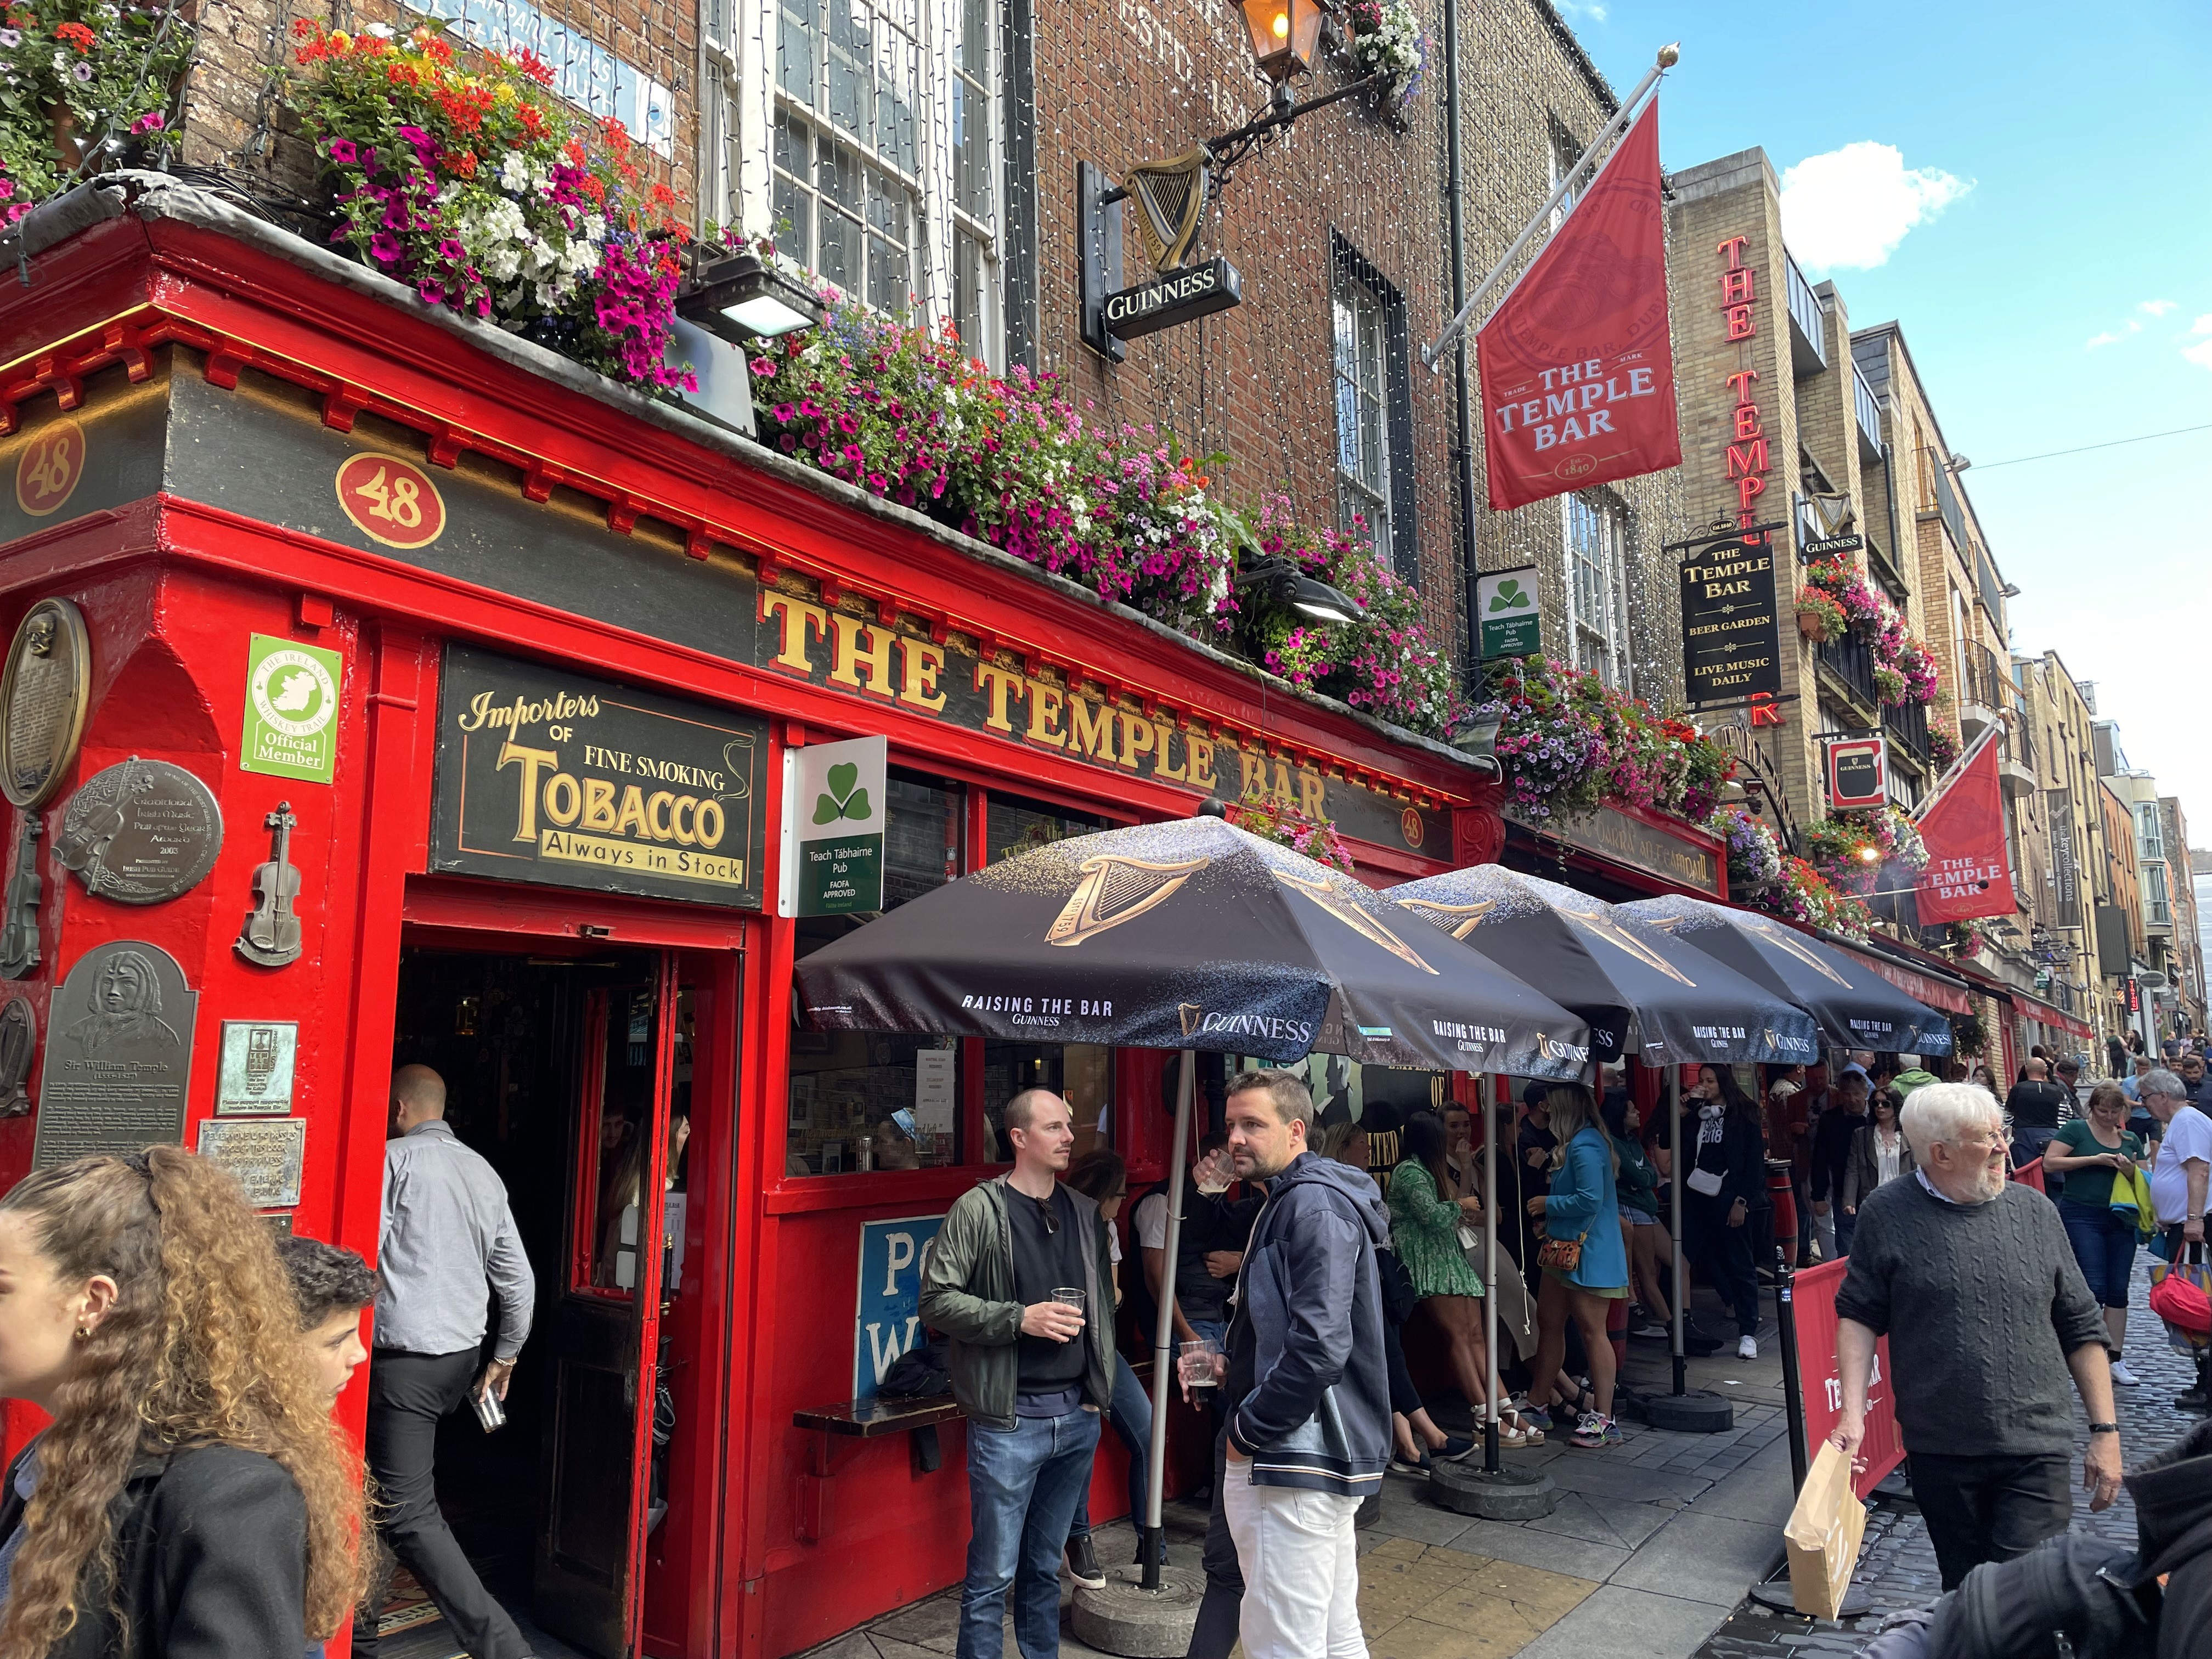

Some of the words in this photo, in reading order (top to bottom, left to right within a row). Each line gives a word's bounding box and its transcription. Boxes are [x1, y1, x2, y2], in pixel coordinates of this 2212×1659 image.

[1147, 229, 1161, 252] 1759
[1107, 268, 1215, 320] GUINNESS
[1717, 235, 1758, 343] THE
[1515, 319, 1567, 359] TEMPLE
[1503, 386, 1526, 397] TRADE
[1538, 358, 1604, 391] THE
[1620, 352, 1643, 363] MARK
[1496, 367, 1657, 434] TEMPLE
[1533, 409, 1617, 452] BAR
[1724, 369, 1773, 544] TEMPL
[25, 437, 70, 498] 48
[1564, 463, 1589, 476] 1840
[355, 466, 422, 528] 48
[1712, 548, 1741, 561] THE
[1805, 537, 1859, 554] GUINNESS
[1684, 557, 1771, 584] TEMPLE
[1705, 579, 1752, 599] BAR
[1488, 623, 1504, 631] Teach
[1689, 623, 1719, 637] BEER
[1721, 615, 1771, 631] GARDEN
[261, 654, 283, 674] THE
[285, 653, 329, 685] IRELAND
[1694, 663, 1724, 676] LIVE
[1726, 657, 1770, 672] MUSIC
[1712, 673, 1752, 687] DAILY
[259, 700, 297, 733] WHISKEY
[301, 715, 326, 733] TRAIL
[459, 691, 600, 742] Importers
[760, 589, 947, 714] THE
[974, 661, 1218, 791] TEMPLE
[1238, 750, 1327, 823] BAR
[265, 732, 317, 753] Official
[549, 724, 573, 743] OF
[258, 746, 321, 767] Member
[1839, 763, 1871, 771] GUINNESS
[583, 745, 631, 774] FINE
[636, 756, 725, 792] SMOKING
[496, 741, 726, 849] TOBACCO
[1045, 823, 1063, 840] The
[1404, 817, 1419, 839] 48
[160, 847, 179, 855] 2003
[545, 832, 634, 865] Always
[648, 848, 667, 870] in
[678, 851, 739, 881] Stock
[809, 851, 832, 862] Teach
[833, 847, 873, 859] Tábhairne
[833, 862, 848, 873] Pub
[1940, 857, 1974, 871] THE
[823, 889, 856, 899] APPROVED
[830, 880, 849, 889] FAOFA
[1939, 884, 1984, 900] BAR
[1057, 913, 1074, 933] 1759
[961, 995, 1032, 1013] RAISING
[1041, 998, 1072, 1014] THE
[1080, 1000, 1113, 1017] BAR
[1012, 1013, 1059, 1026] GUINNESS
[1203, 1012, 1311, 1042] GUINNESS
[1871, 1020, 1881, 1031] THE
[1433, 1019, 1467, 1040] RAISING
[1469, 1024, 1487, 1042] THE
[1488, 1027, 1506, 1043] BAR
[1692, 1026, 1717, 1039] RAISING
[1718, 1026, 1729, 1039] THE
[1731, 1027, 1746, 1039] BAR
[1457, 1039, 1485, 1053] GUINNESS
[64, 1060, 81, 1071] Sir
[83, 1060, 126, 1071] William
[129, 1061, 168, 1074] Temple
[1431, 1076, 1445, 1108] OF
[1701, 1127, 1723, 1143] 2018
